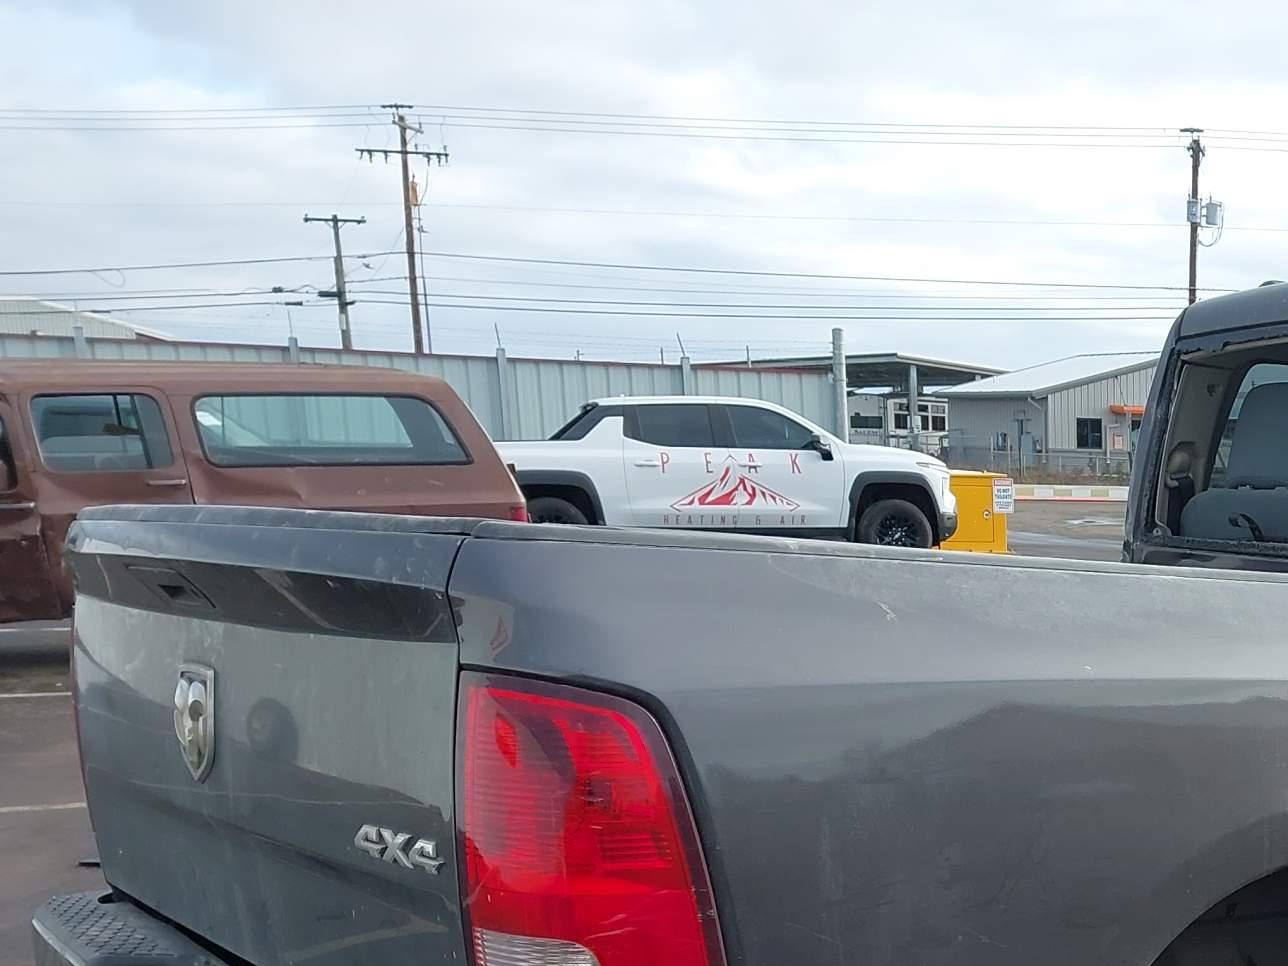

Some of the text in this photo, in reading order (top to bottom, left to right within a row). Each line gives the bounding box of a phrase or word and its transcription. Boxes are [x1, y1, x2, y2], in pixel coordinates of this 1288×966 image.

[660, 452, 802, 474] PEAK
[663, 514, 738, 526] HEATING
[780, 514, 807, 526] AIR
